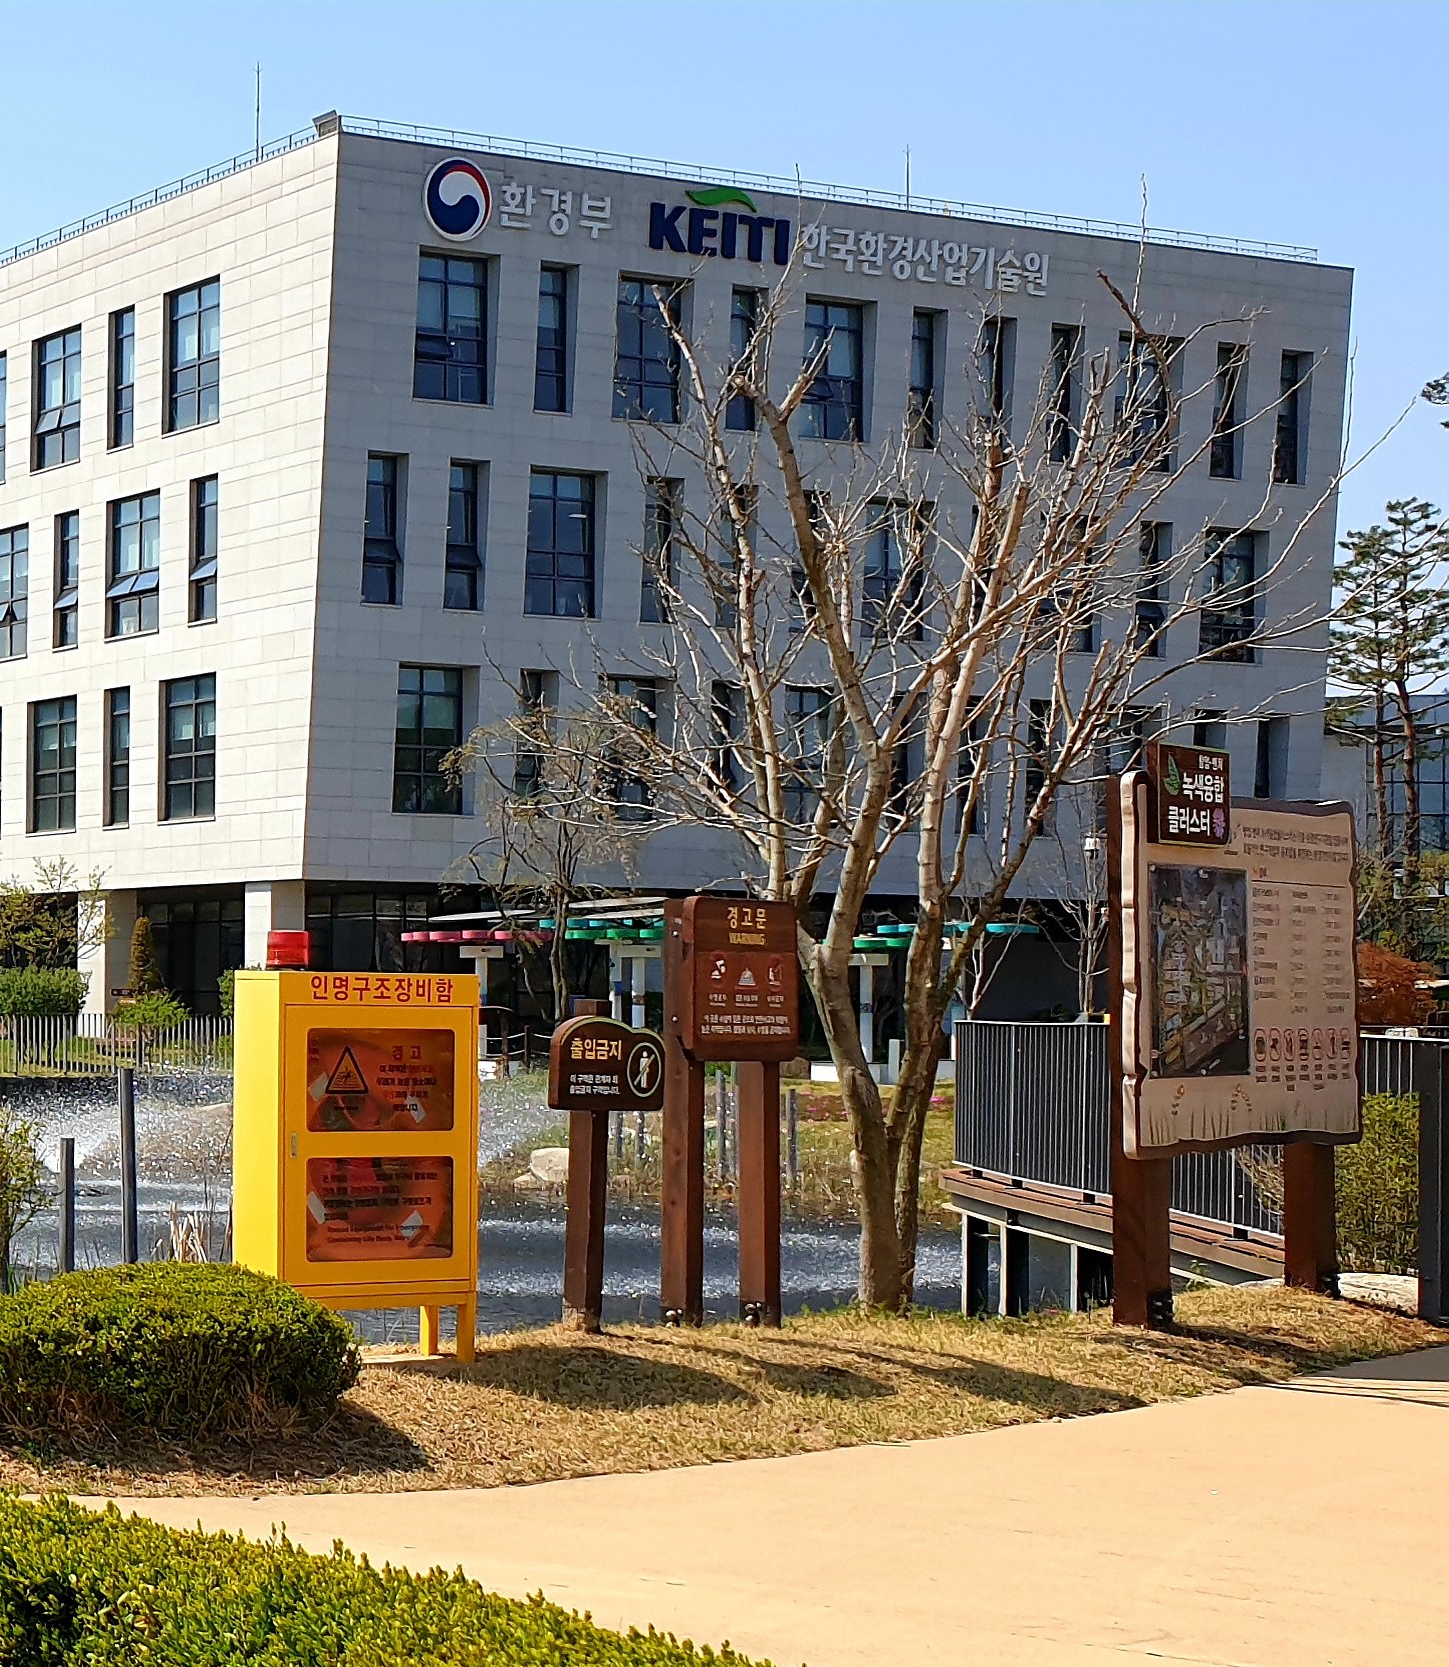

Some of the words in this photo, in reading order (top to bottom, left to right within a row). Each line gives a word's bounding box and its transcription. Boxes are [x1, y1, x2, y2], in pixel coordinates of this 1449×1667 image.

[500, 182, 613, 240] 환경부
[648, 201, 791, 266] KEITI
[800, 223, 1050, 297] 한국환경산업기술원
[1182, 772, 1225, 803] 녹색융합
[1168, 805, 1211, 836] 클러스터
[726, 906, 767, 929] 경고문
[310, 975, 454, 1003] 인명구조장비함
[570, 1037, 622, 1061] 출입금지
